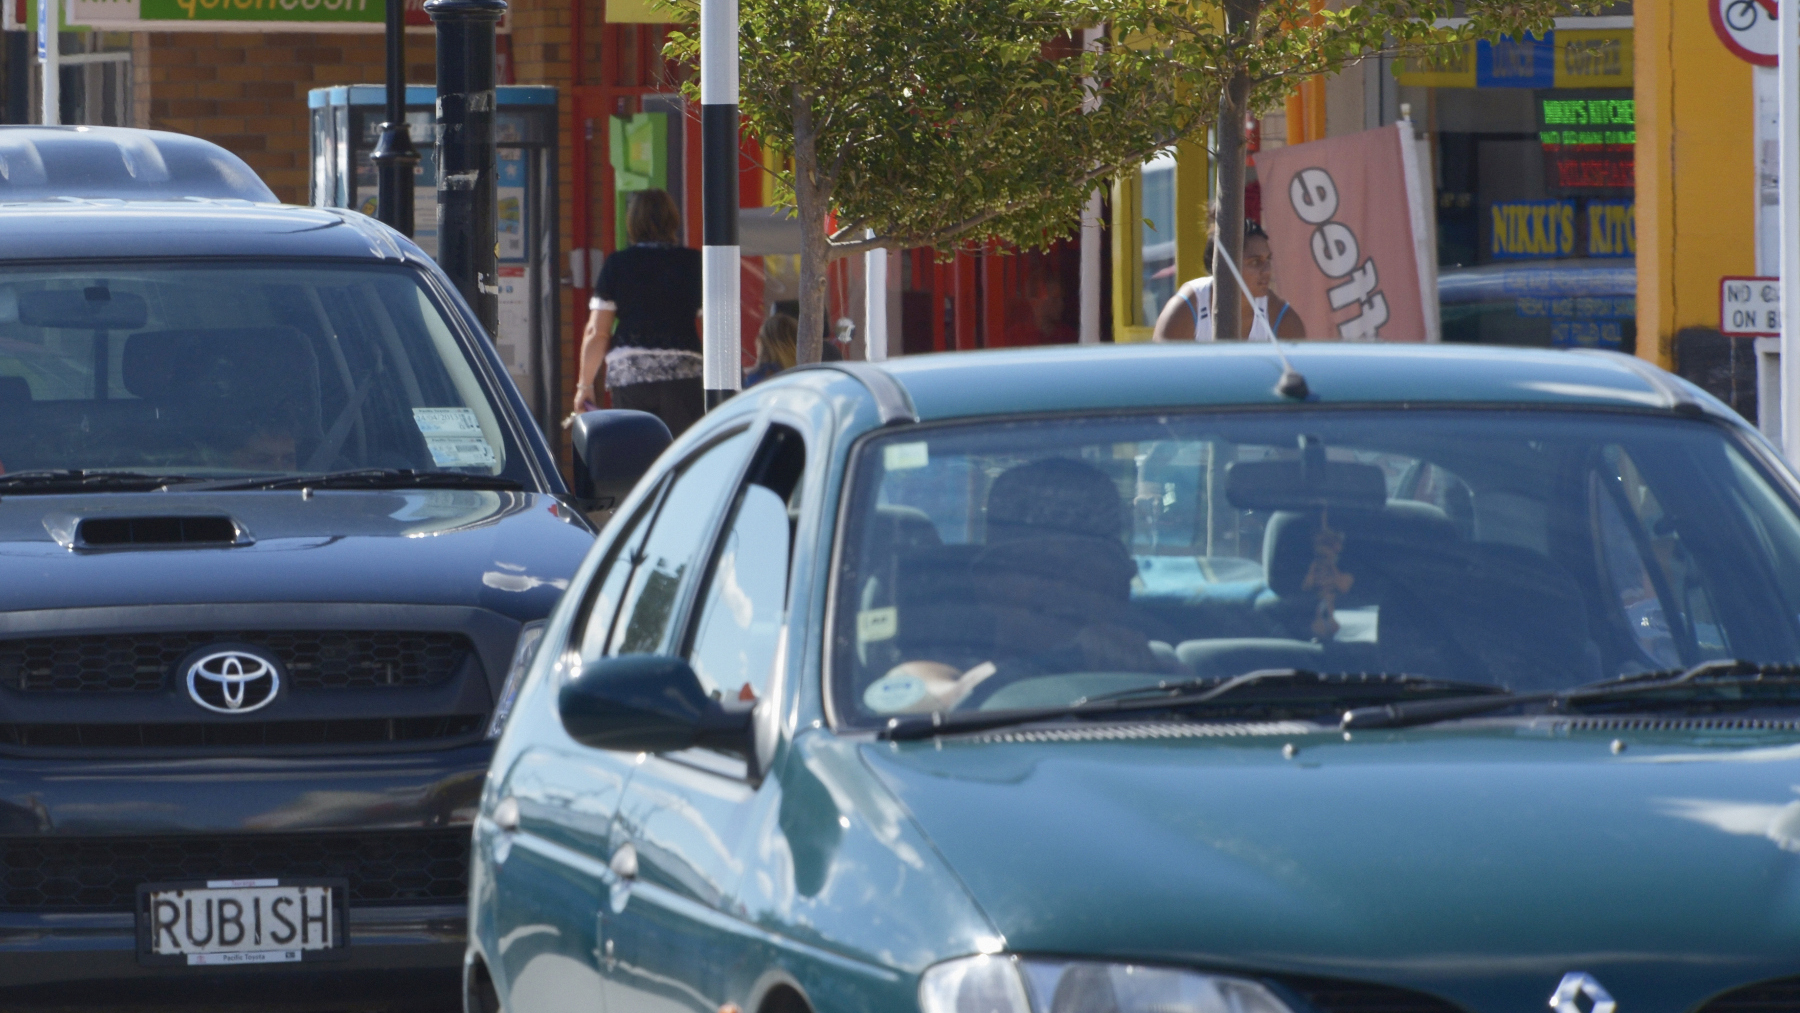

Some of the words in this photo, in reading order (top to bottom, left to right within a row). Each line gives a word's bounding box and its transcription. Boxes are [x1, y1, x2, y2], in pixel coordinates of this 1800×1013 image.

[1491, 202, 1575, 255] NIKKI'S
[1727, 284, 1752, 303] NO
[1733, 310, 1757, 328] ON
[152, 895, 330, 948] RUBISH
[222, 953, 243, 963] Pacific
[244, 952, 266, 962] Toyota
